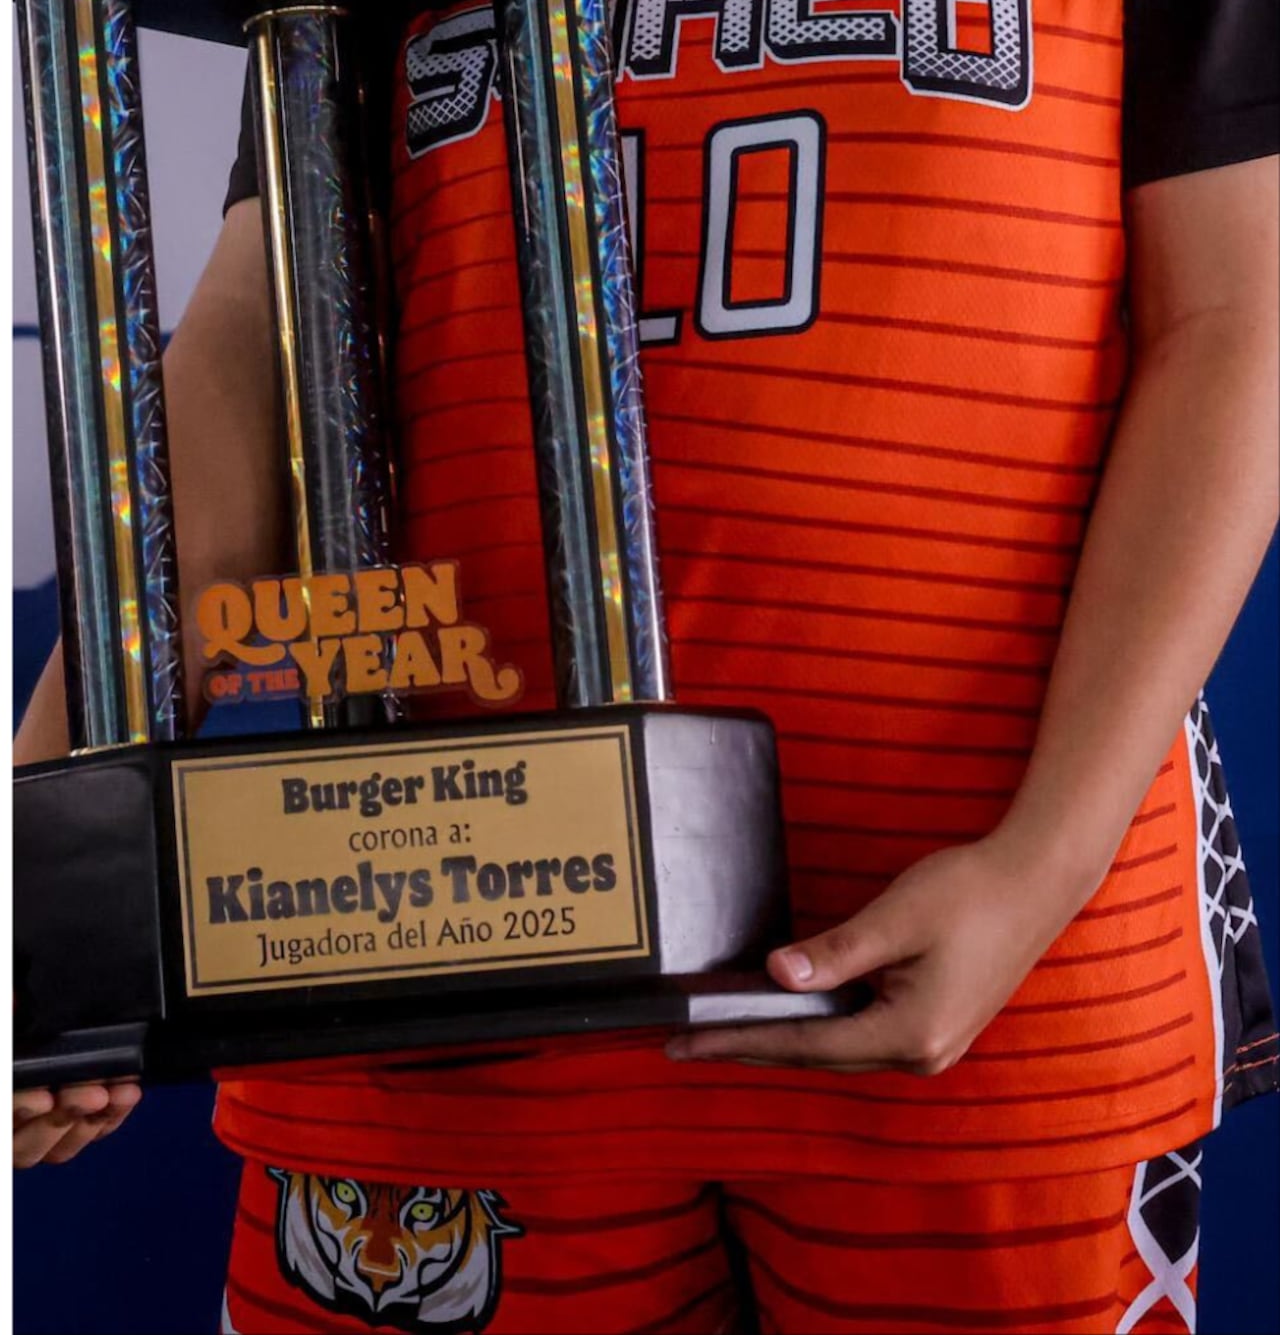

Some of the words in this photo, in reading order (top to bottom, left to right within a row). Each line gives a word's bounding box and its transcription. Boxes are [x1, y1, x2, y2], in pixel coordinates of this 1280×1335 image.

[196, 565, 460, 666] QUEEN
[210, 674, 242, 697] OF
[247, 668, 300, 693] THE
[289, 625, 520, 700] YEAR
[282, 772, 424, 818] Burger
[431, 759, 528, 806] King
[349, 823, 438, 853] corona
[448, 823, 472, 844] a:
[207, 860, 433, 924] Kianelys
[441, 852, 618, 903] Torres
[257, 928, 376, 967] Jugadora
[387, 920, 426, 950] del
[437, 917, 492, 946] Año
[503, 906, 576, 940] 2025
